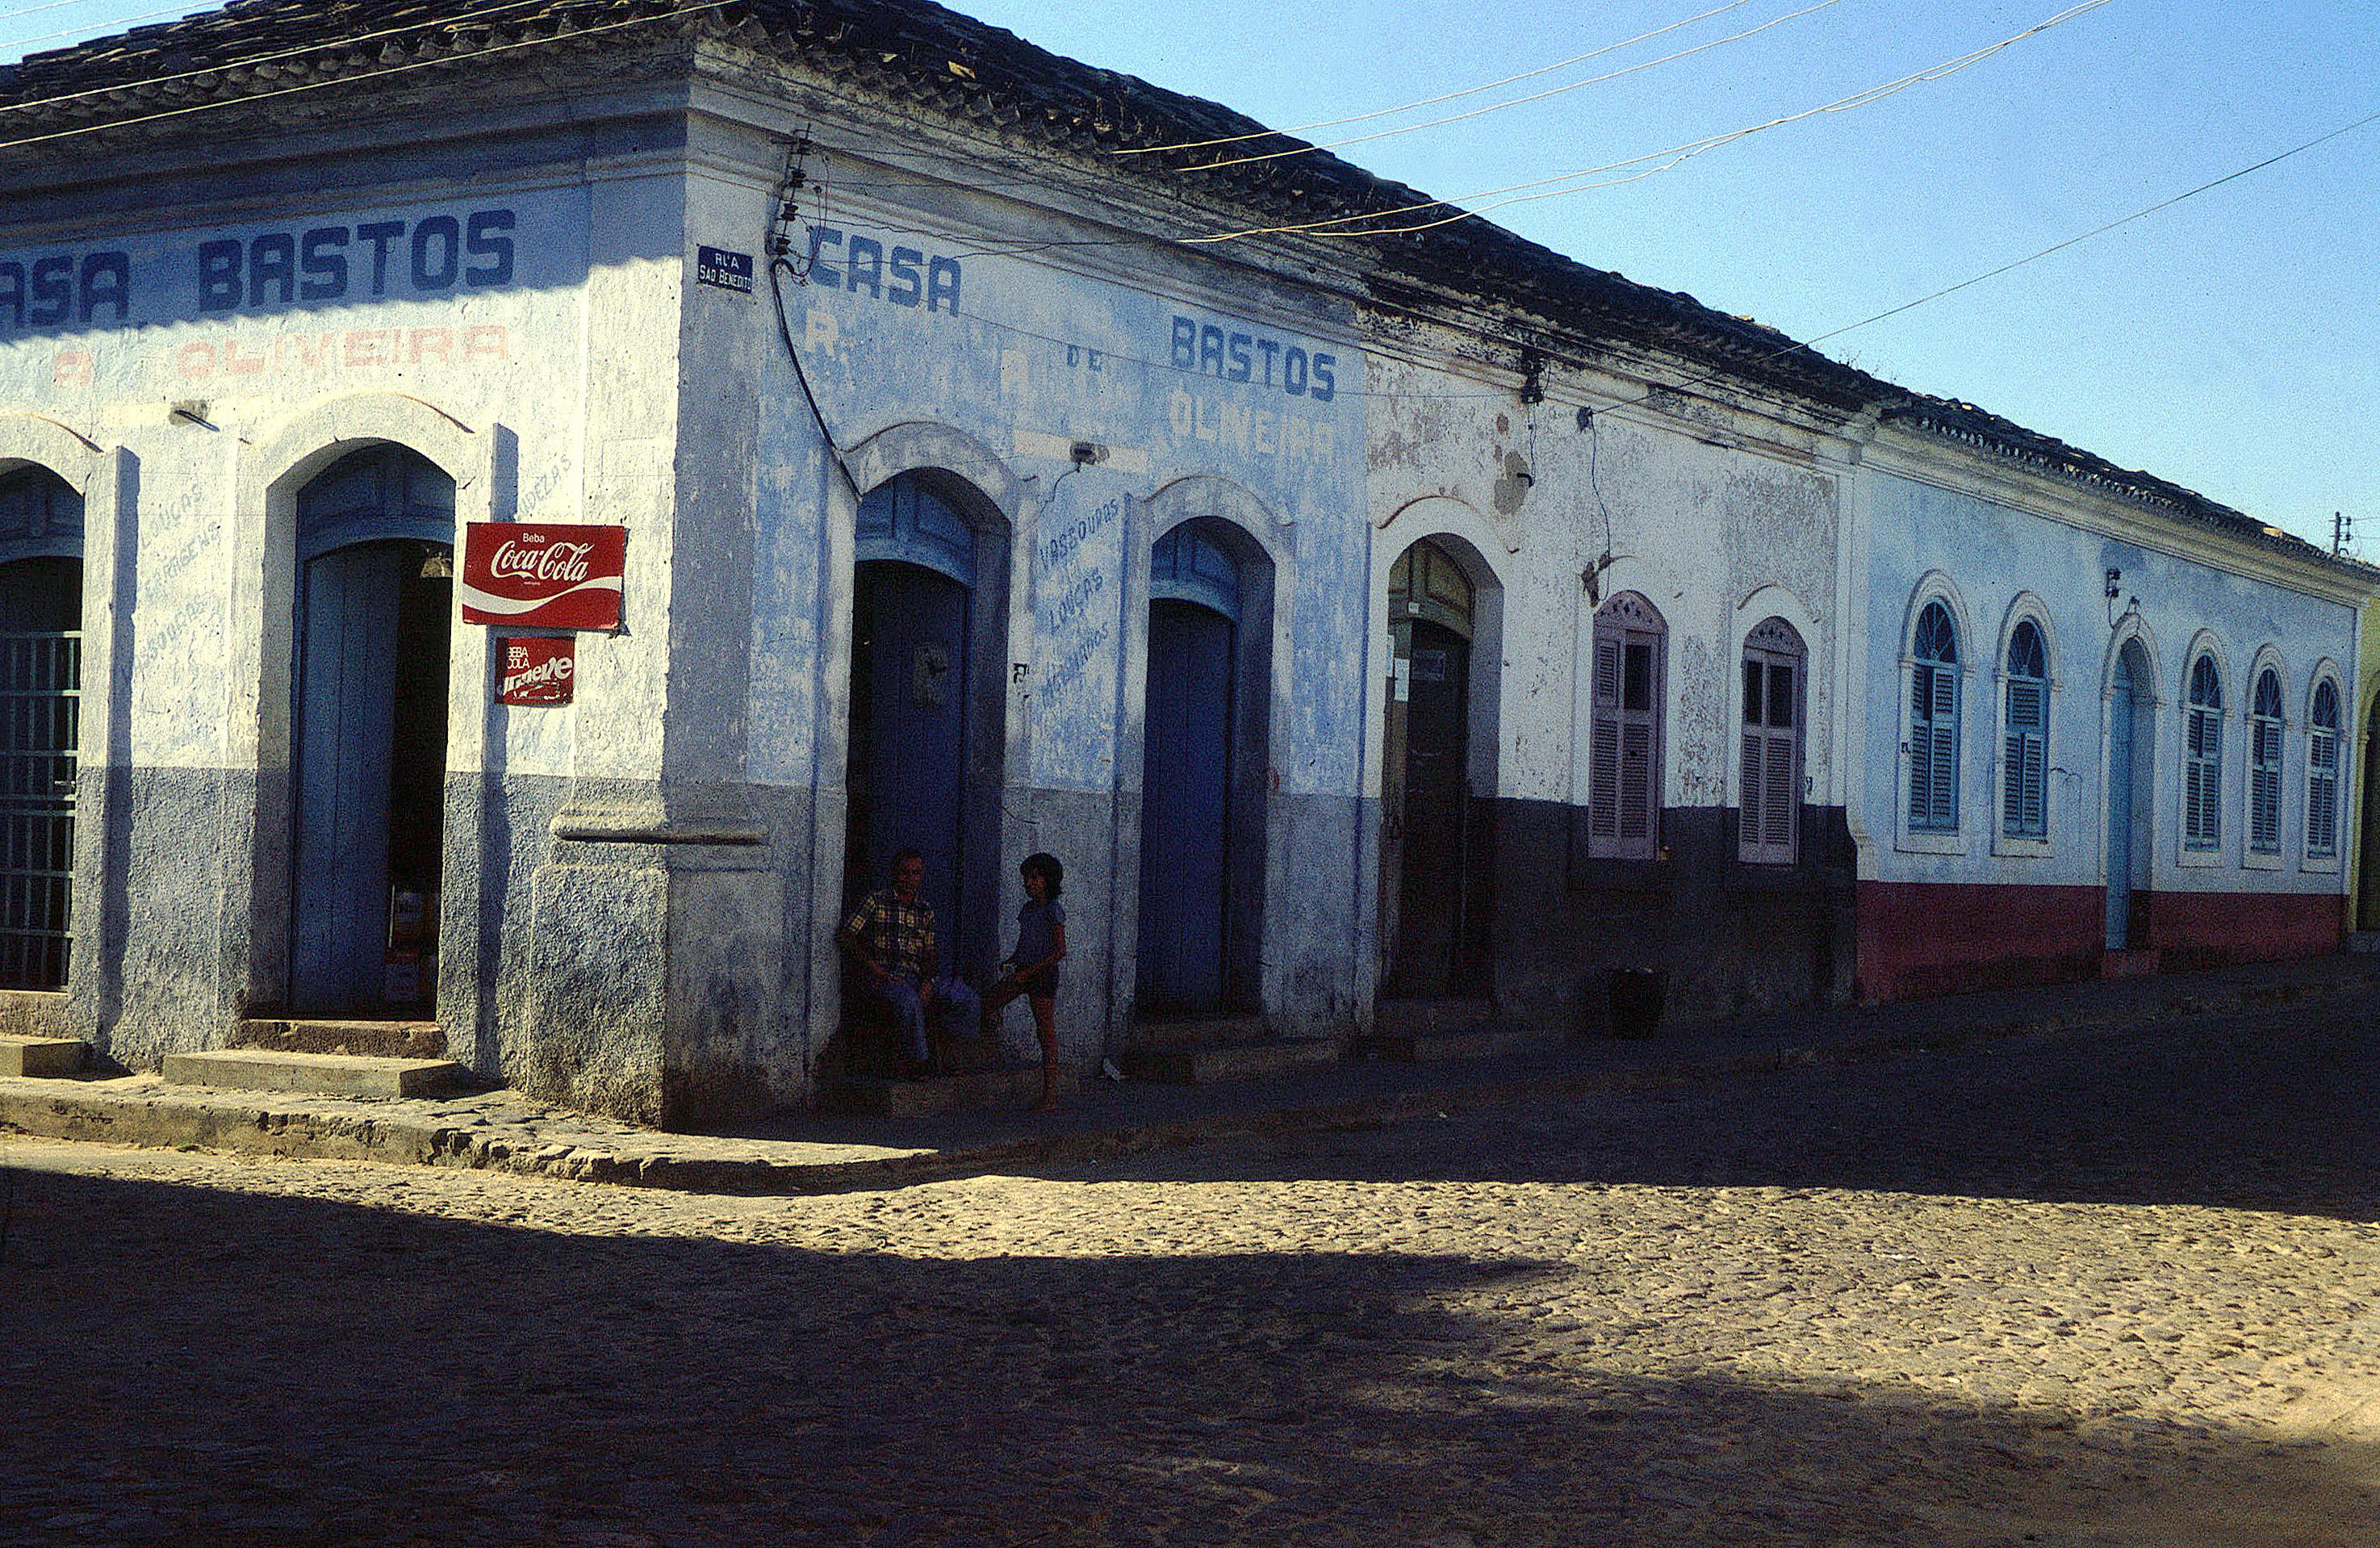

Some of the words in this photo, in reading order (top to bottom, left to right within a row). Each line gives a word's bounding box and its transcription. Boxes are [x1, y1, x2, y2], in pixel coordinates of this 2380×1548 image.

[199, 209, 516, 312] BASTOS
[715, 253, 740, 270] RUA
[809, 226, 963, 318] CASA
[1067, 344, 1102, 371] DE
[1172, 315, 1336, 402] BASTOS
[176, 324, 507, 379] OLIVEIRA
[523, 533, 545, 543] Beba
[507, 646, 529, 658] BEBA
[507, 658, 530, 669] COLA
